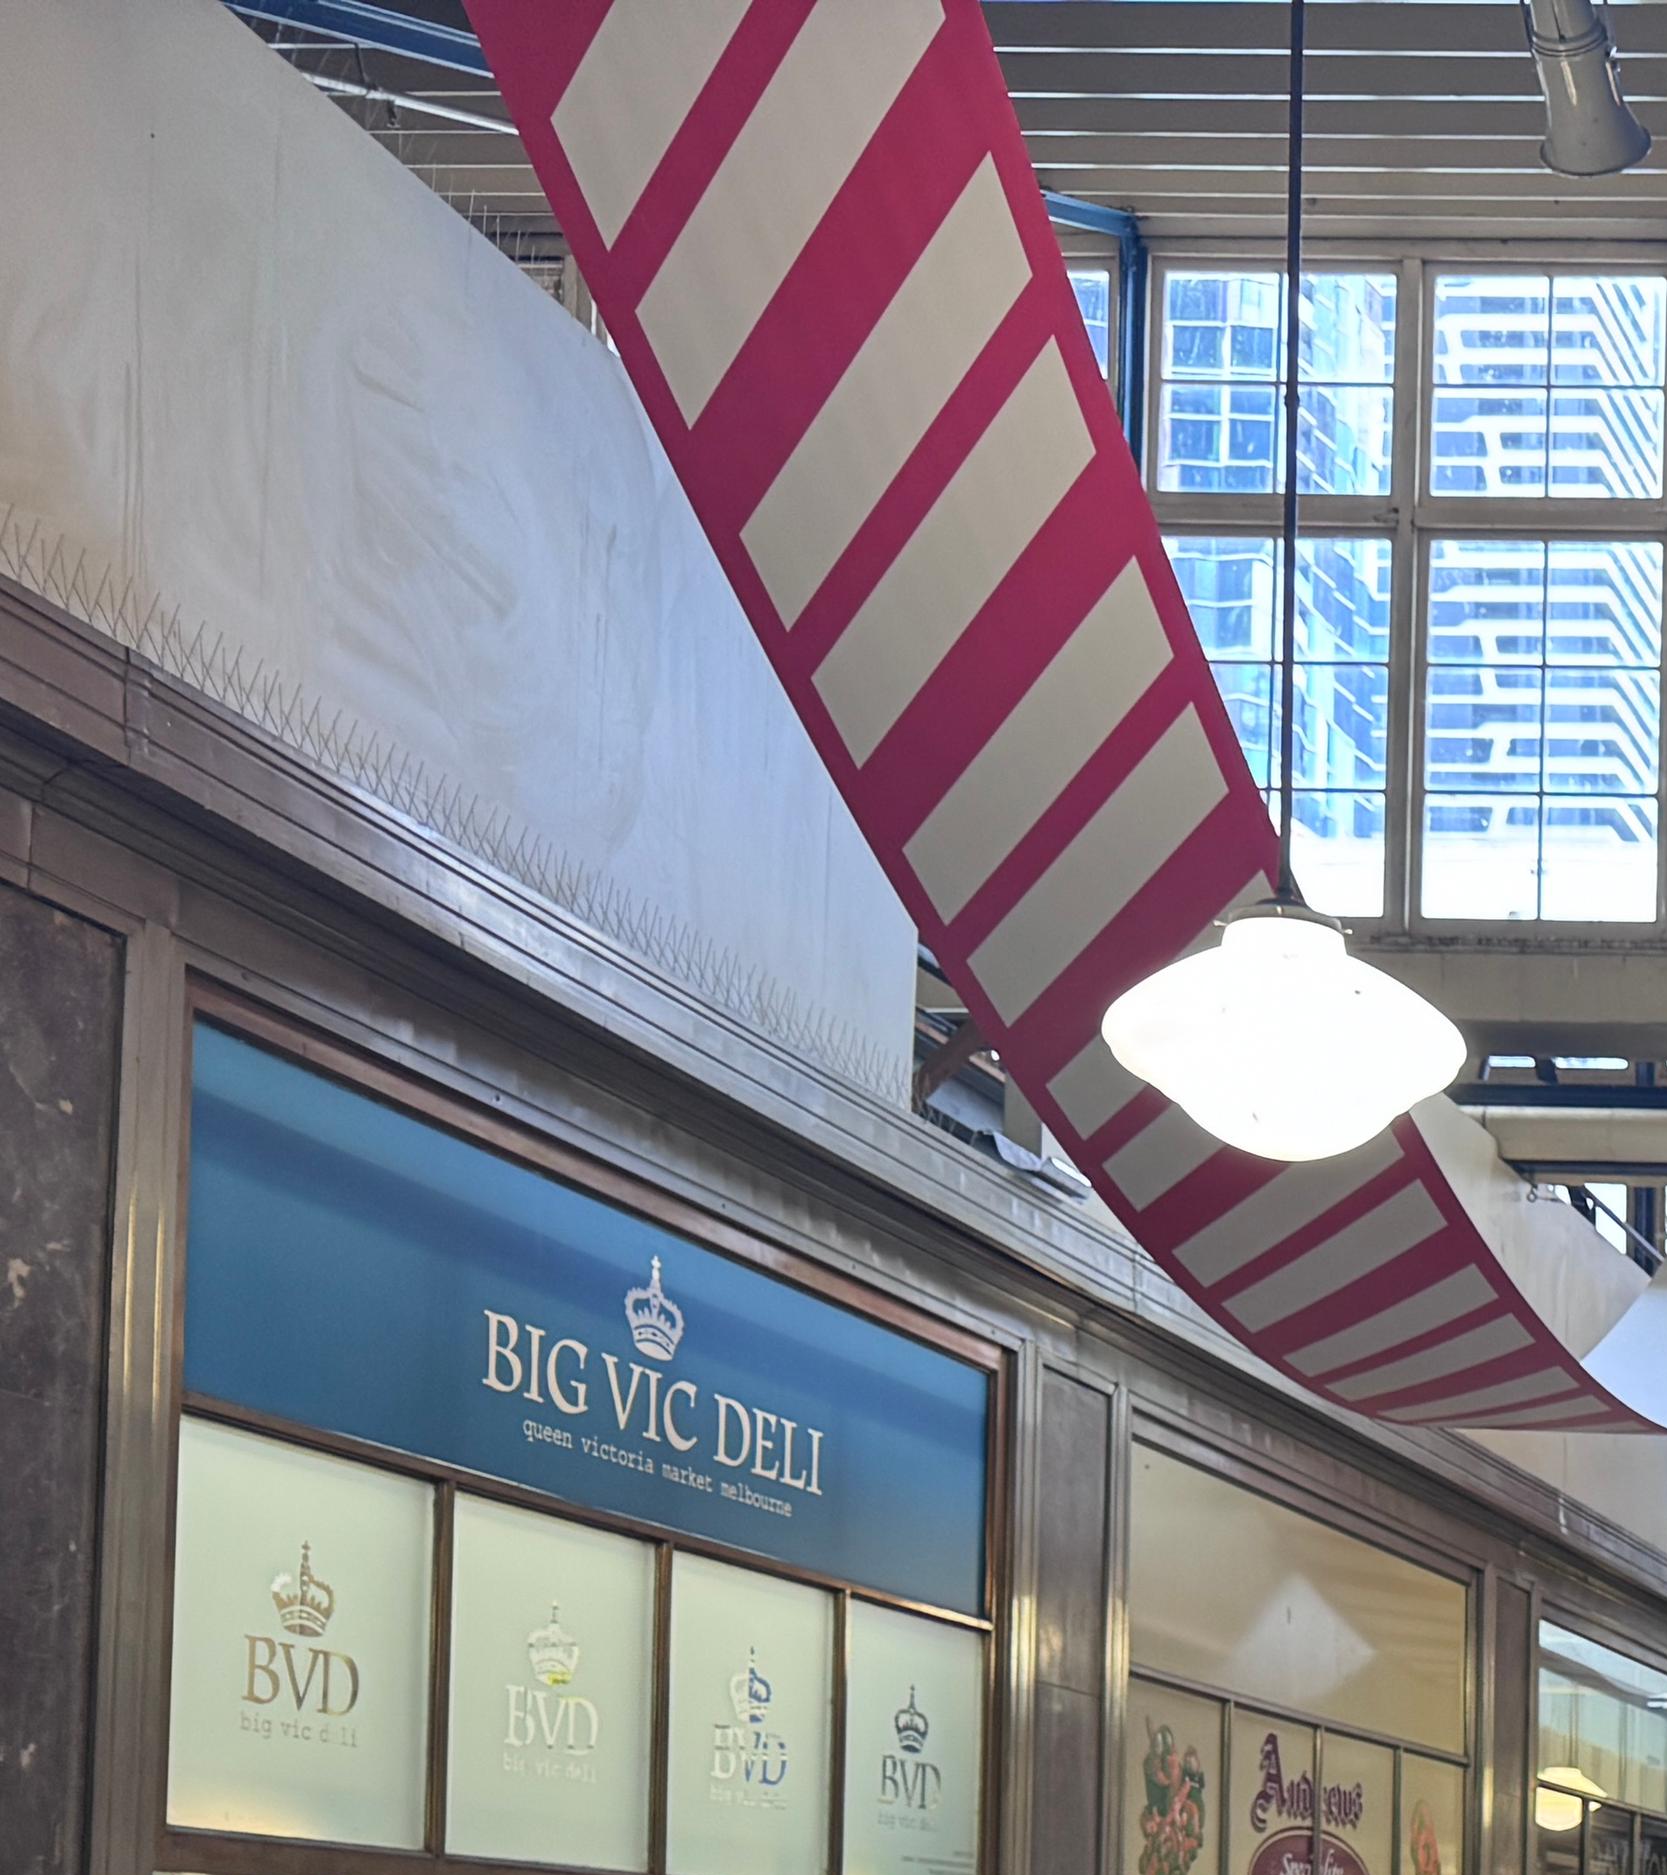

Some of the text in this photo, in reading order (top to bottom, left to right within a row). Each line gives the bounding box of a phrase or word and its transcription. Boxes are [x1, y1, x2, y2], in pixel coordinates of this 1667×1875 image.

[482, 1309, 824, 1496] BIG VIC DELI
[523, 1418, 793, 1518] queen victoria market melbourne
[241, 1633, 360, 1717] BVD
[239, 1711, 273, 1739] big
[281, 1716, 312, 1741] vic
[503, 1684, 599, 1756] BVD
[709, 1723, 788, 1786] BVD
[876, 1755, 942, 1811] BVD
[1251, 1731, 1364, 1833] Andews
